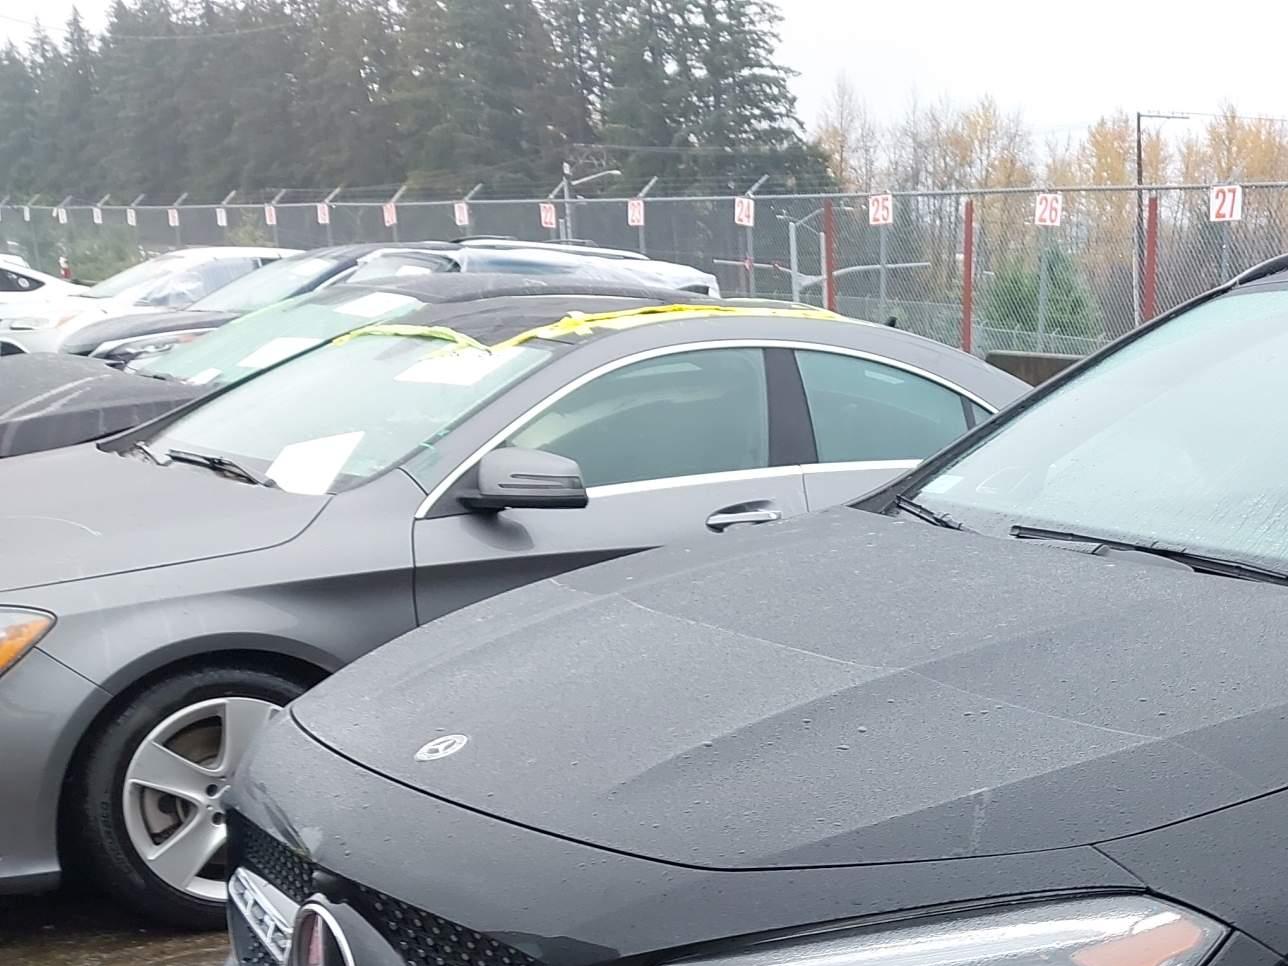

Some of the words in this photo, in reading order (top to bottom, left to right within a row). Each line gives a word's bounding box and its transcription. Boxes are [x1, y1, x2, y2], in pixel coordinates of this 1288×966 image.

[736, 199, 751, 224] 24
[871, 196, 890, 222] 25
[1038, 195, 1058, 223] 26
[1215, 188, 1237, 219] 27
